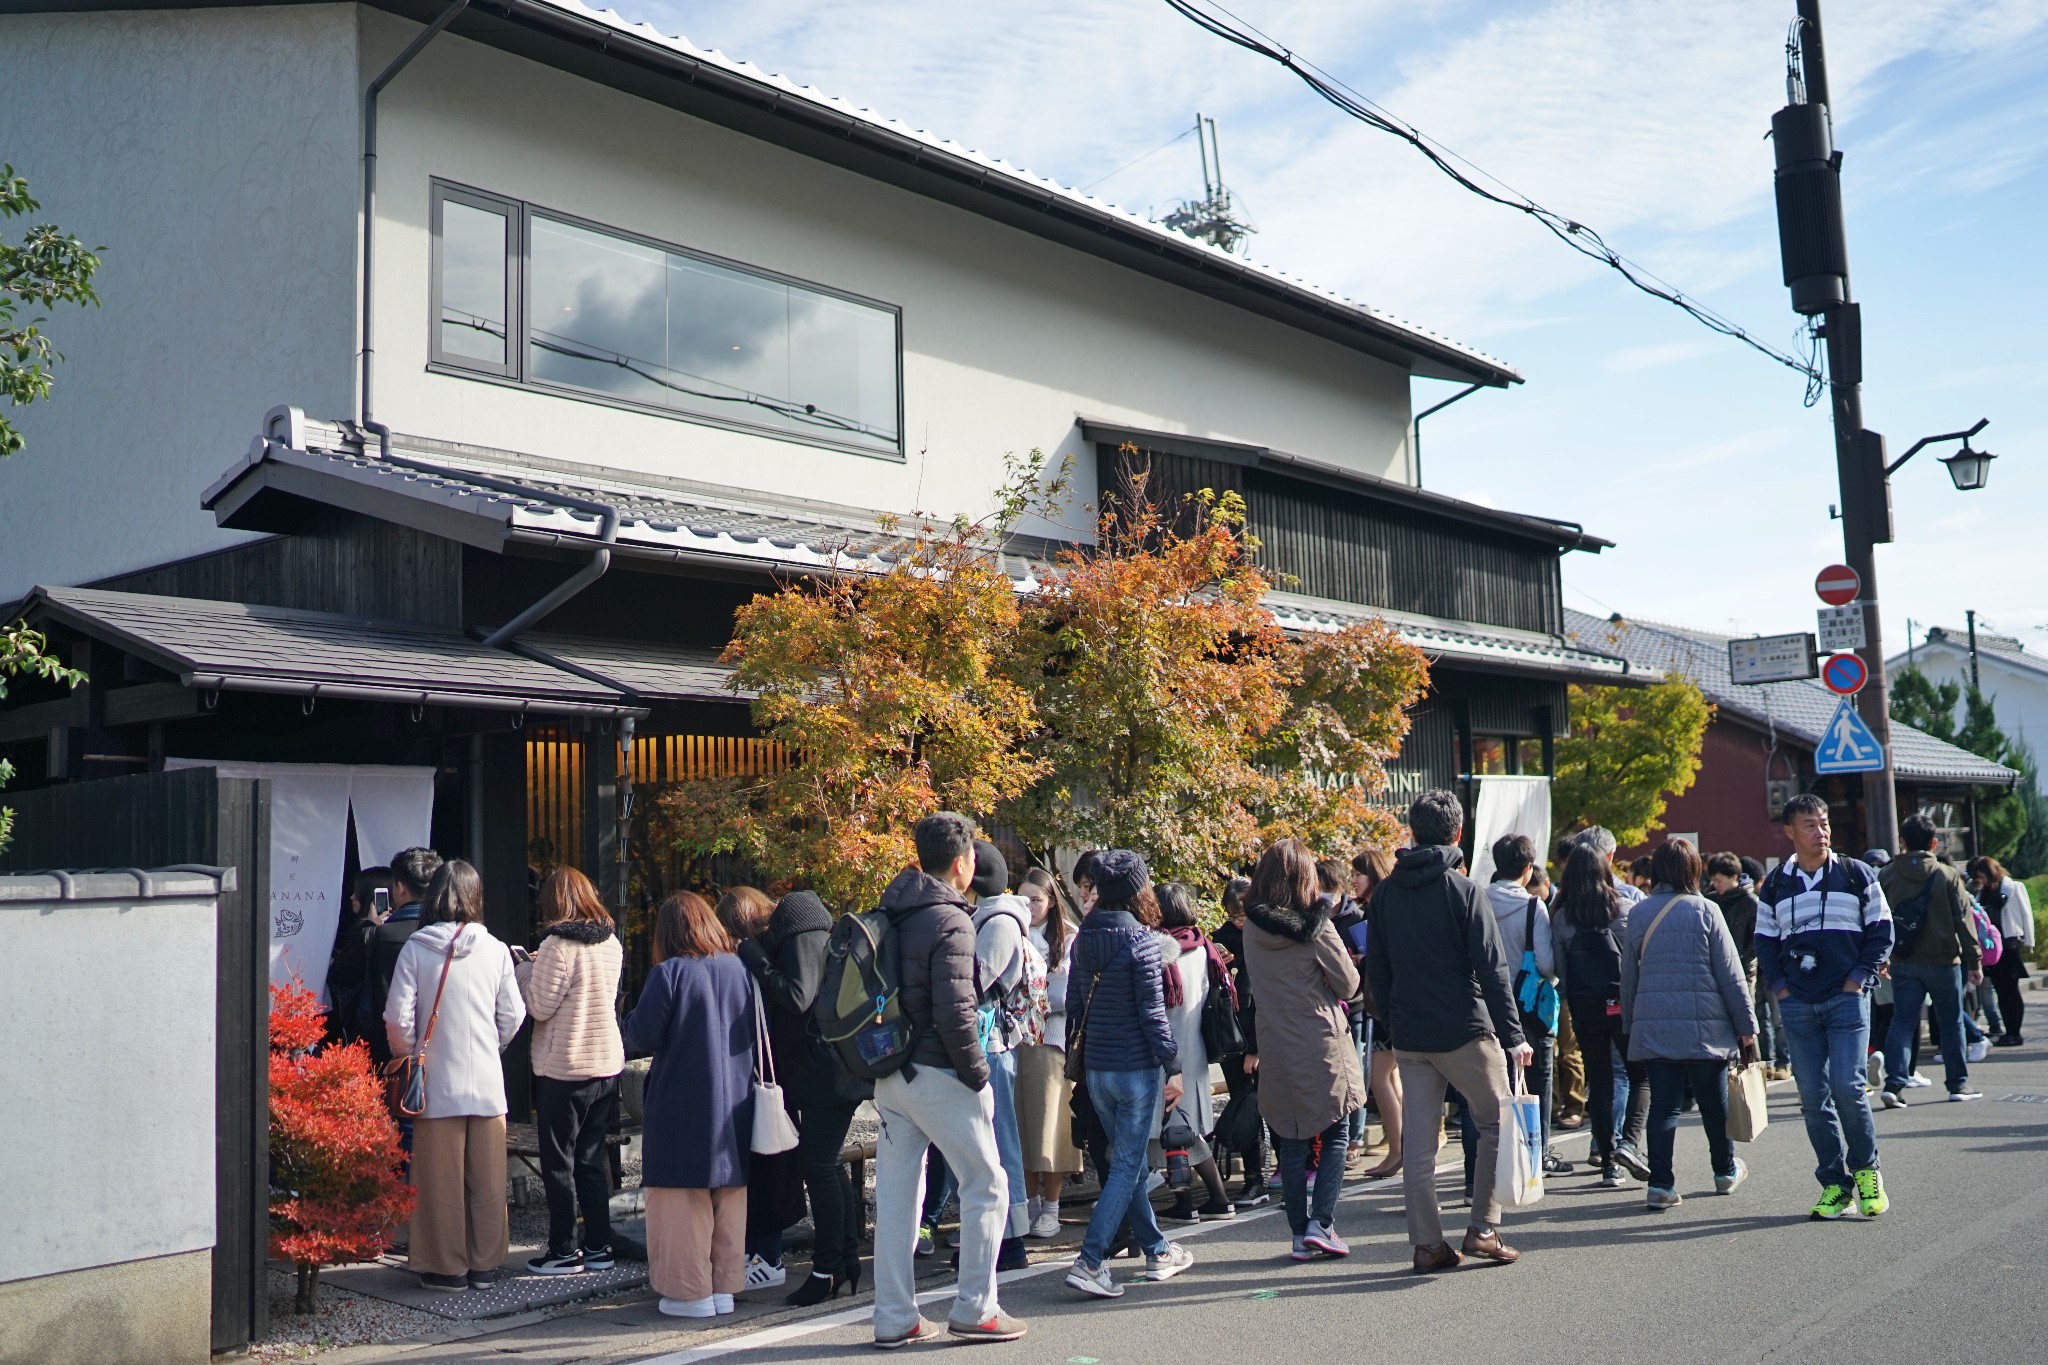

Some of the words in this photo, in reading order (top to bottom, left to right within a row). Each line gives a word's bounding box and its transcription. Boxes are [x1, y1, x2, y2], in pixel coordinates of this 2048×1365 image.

[1819, 607, 1861, 619] 自動車
[1376, 771, 1421, 793] AINT
